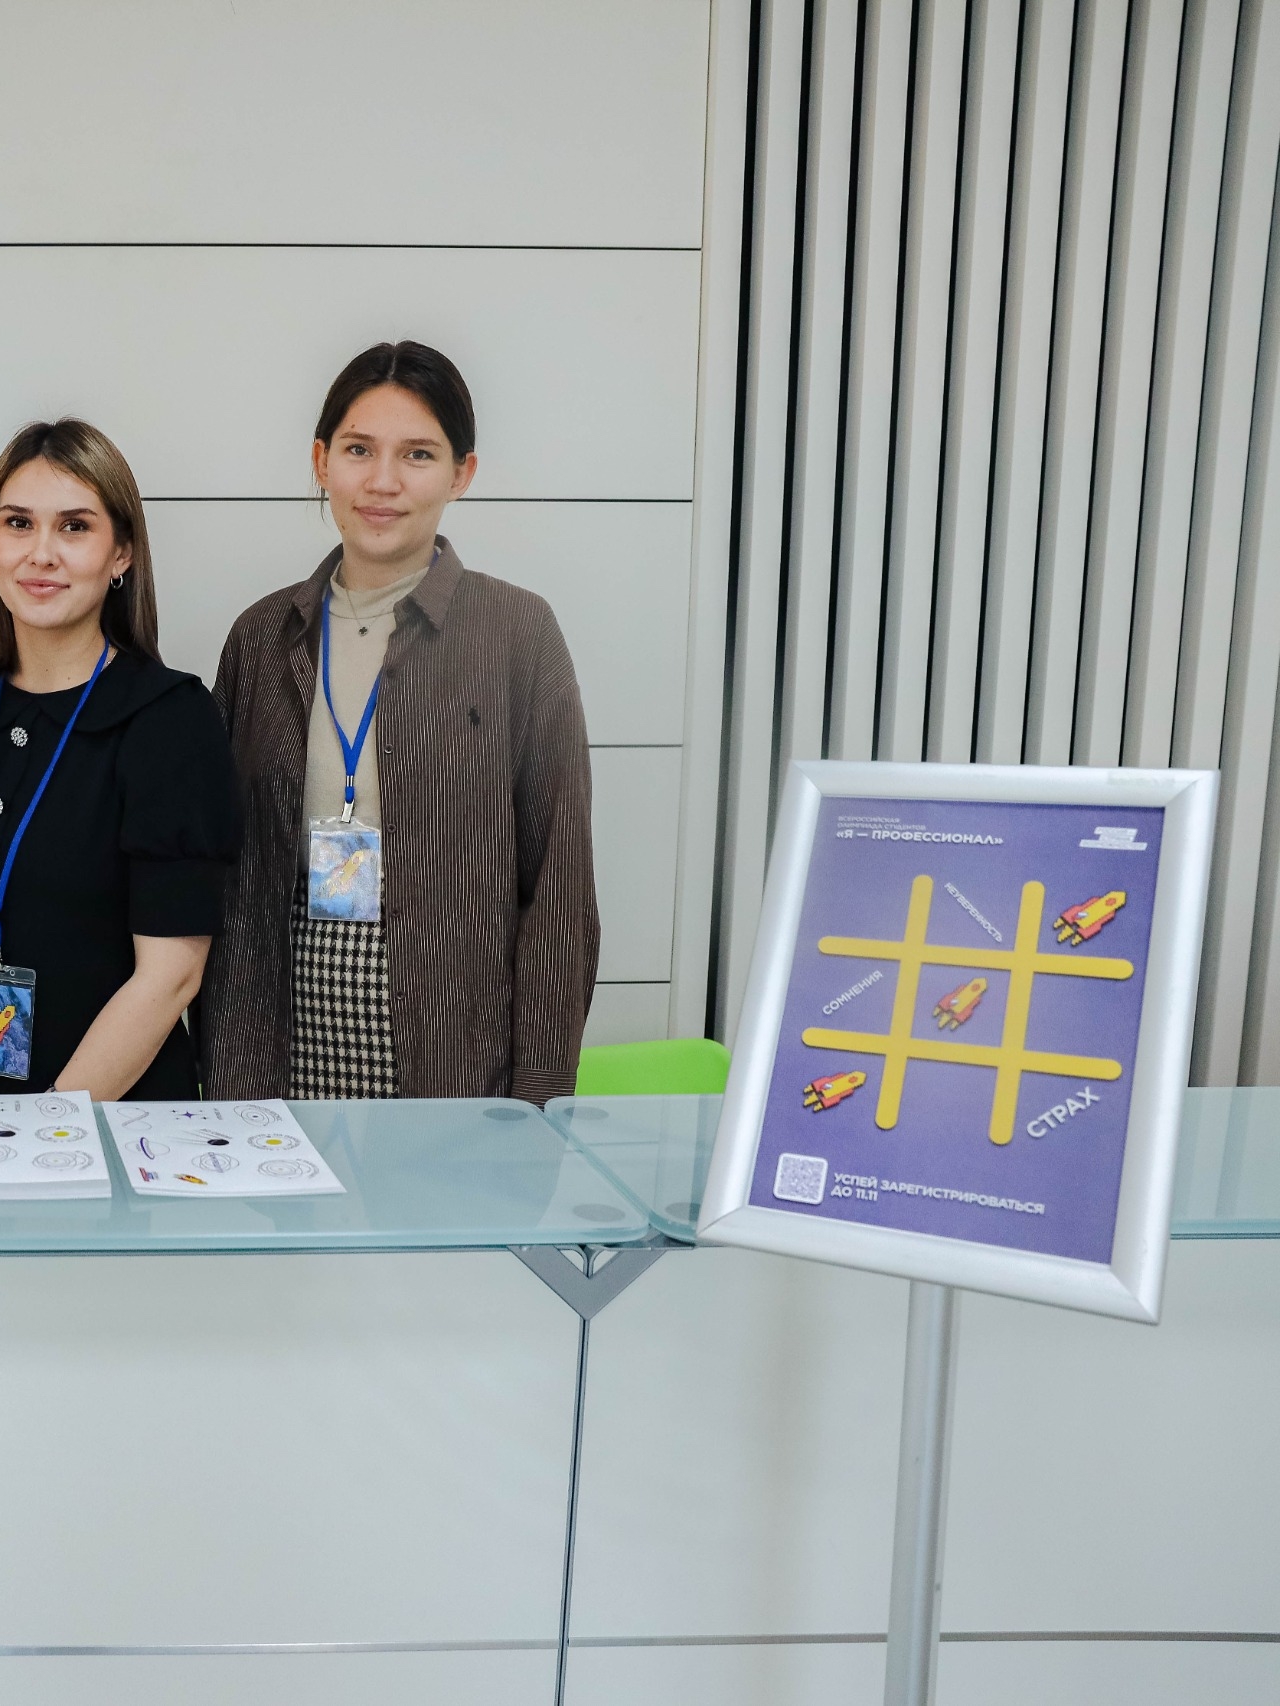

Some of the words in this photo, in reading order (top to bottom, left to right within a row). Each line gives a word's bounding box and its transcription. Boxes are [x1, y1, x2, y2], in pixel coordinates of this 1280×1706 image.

[871, 830, 1005, 846] ПРОФЕССИОНАЛ»
[943, 882, 1003, 943] НЕУВЕРЕННОСТЬ
[822, 970, 884, 1015] СОМНЕНИЯ
[1026, 1085, 1101, 1138] СТРАХ
[830, 1185, 853, 1198] ДО
[855, 1187, 879, 1201] 11.11
[834, 1172, 878, 1189] УСПЕЙ
[879, 1179, 1046, 1216] ЗАРЕГИСТРИРОВАТЬСЯ
